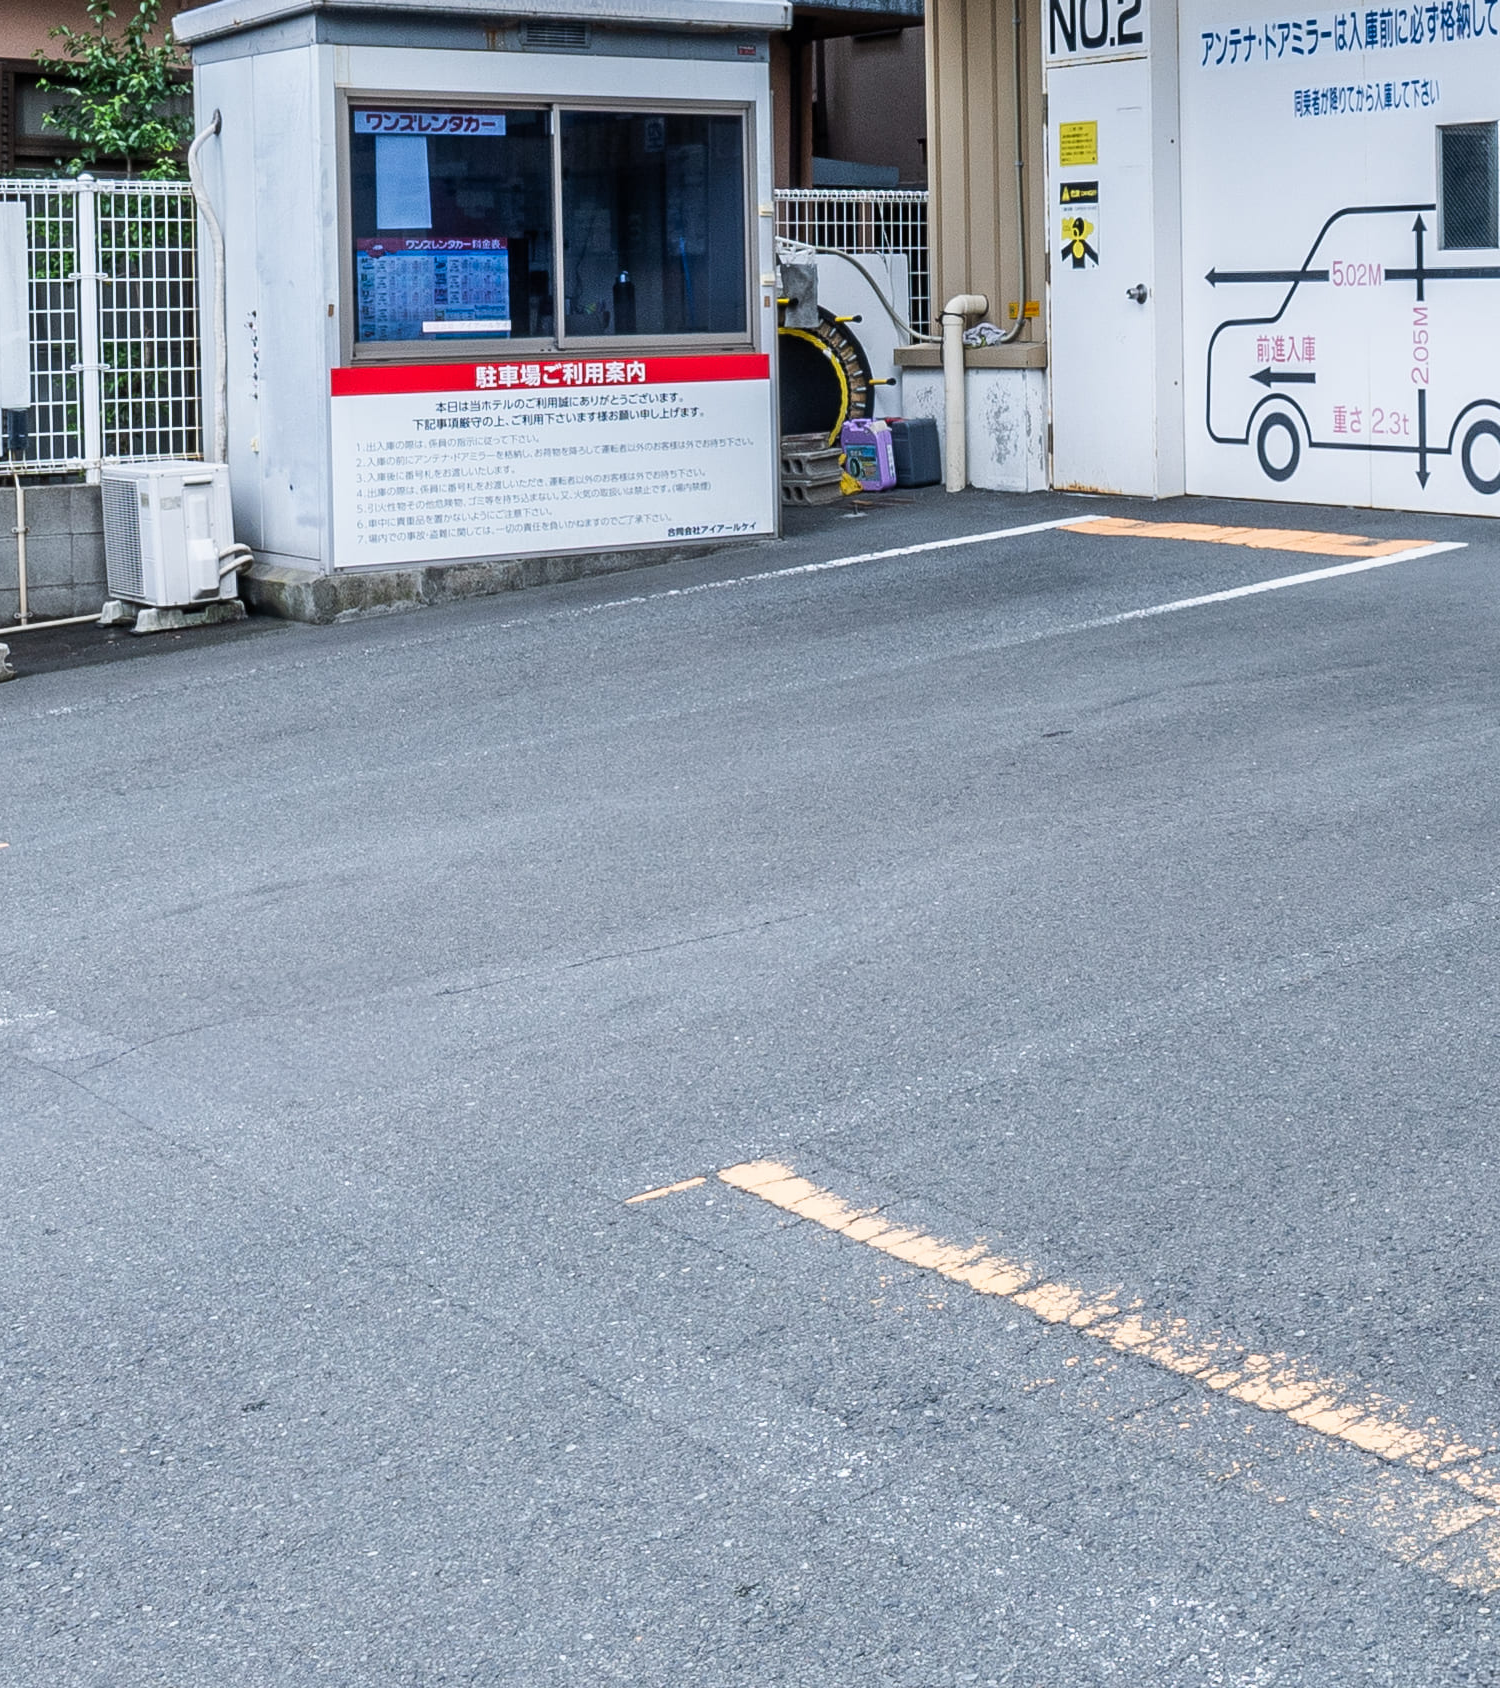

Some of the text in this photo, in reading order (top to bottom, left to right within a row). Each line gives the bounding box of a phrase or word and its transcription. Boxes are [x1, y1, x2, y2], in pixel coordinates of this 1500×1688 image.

[1293, 79, 1440, 119] 同乗者が降りてから入庫して下さい
[365, 113, 496, 133] ワンズレンタカー
[1331, 260, 1382, 288] 5.02M
[1256, 335, 1317, 364] 前進入庫
[1410, 306, 1430, 385] 2.05M
[475, 362, 646, 388] 駐車場ご利用案内
[435, 392, 685, 413] 本日は当ホテルのご利用誠にありがとうございます。
[412, 407, 705, 432] 下記事項厳守の上、ご利用下さいます様お願い申し上げます。
[1333, 405, 1410, 437] 重さ 2.3t
